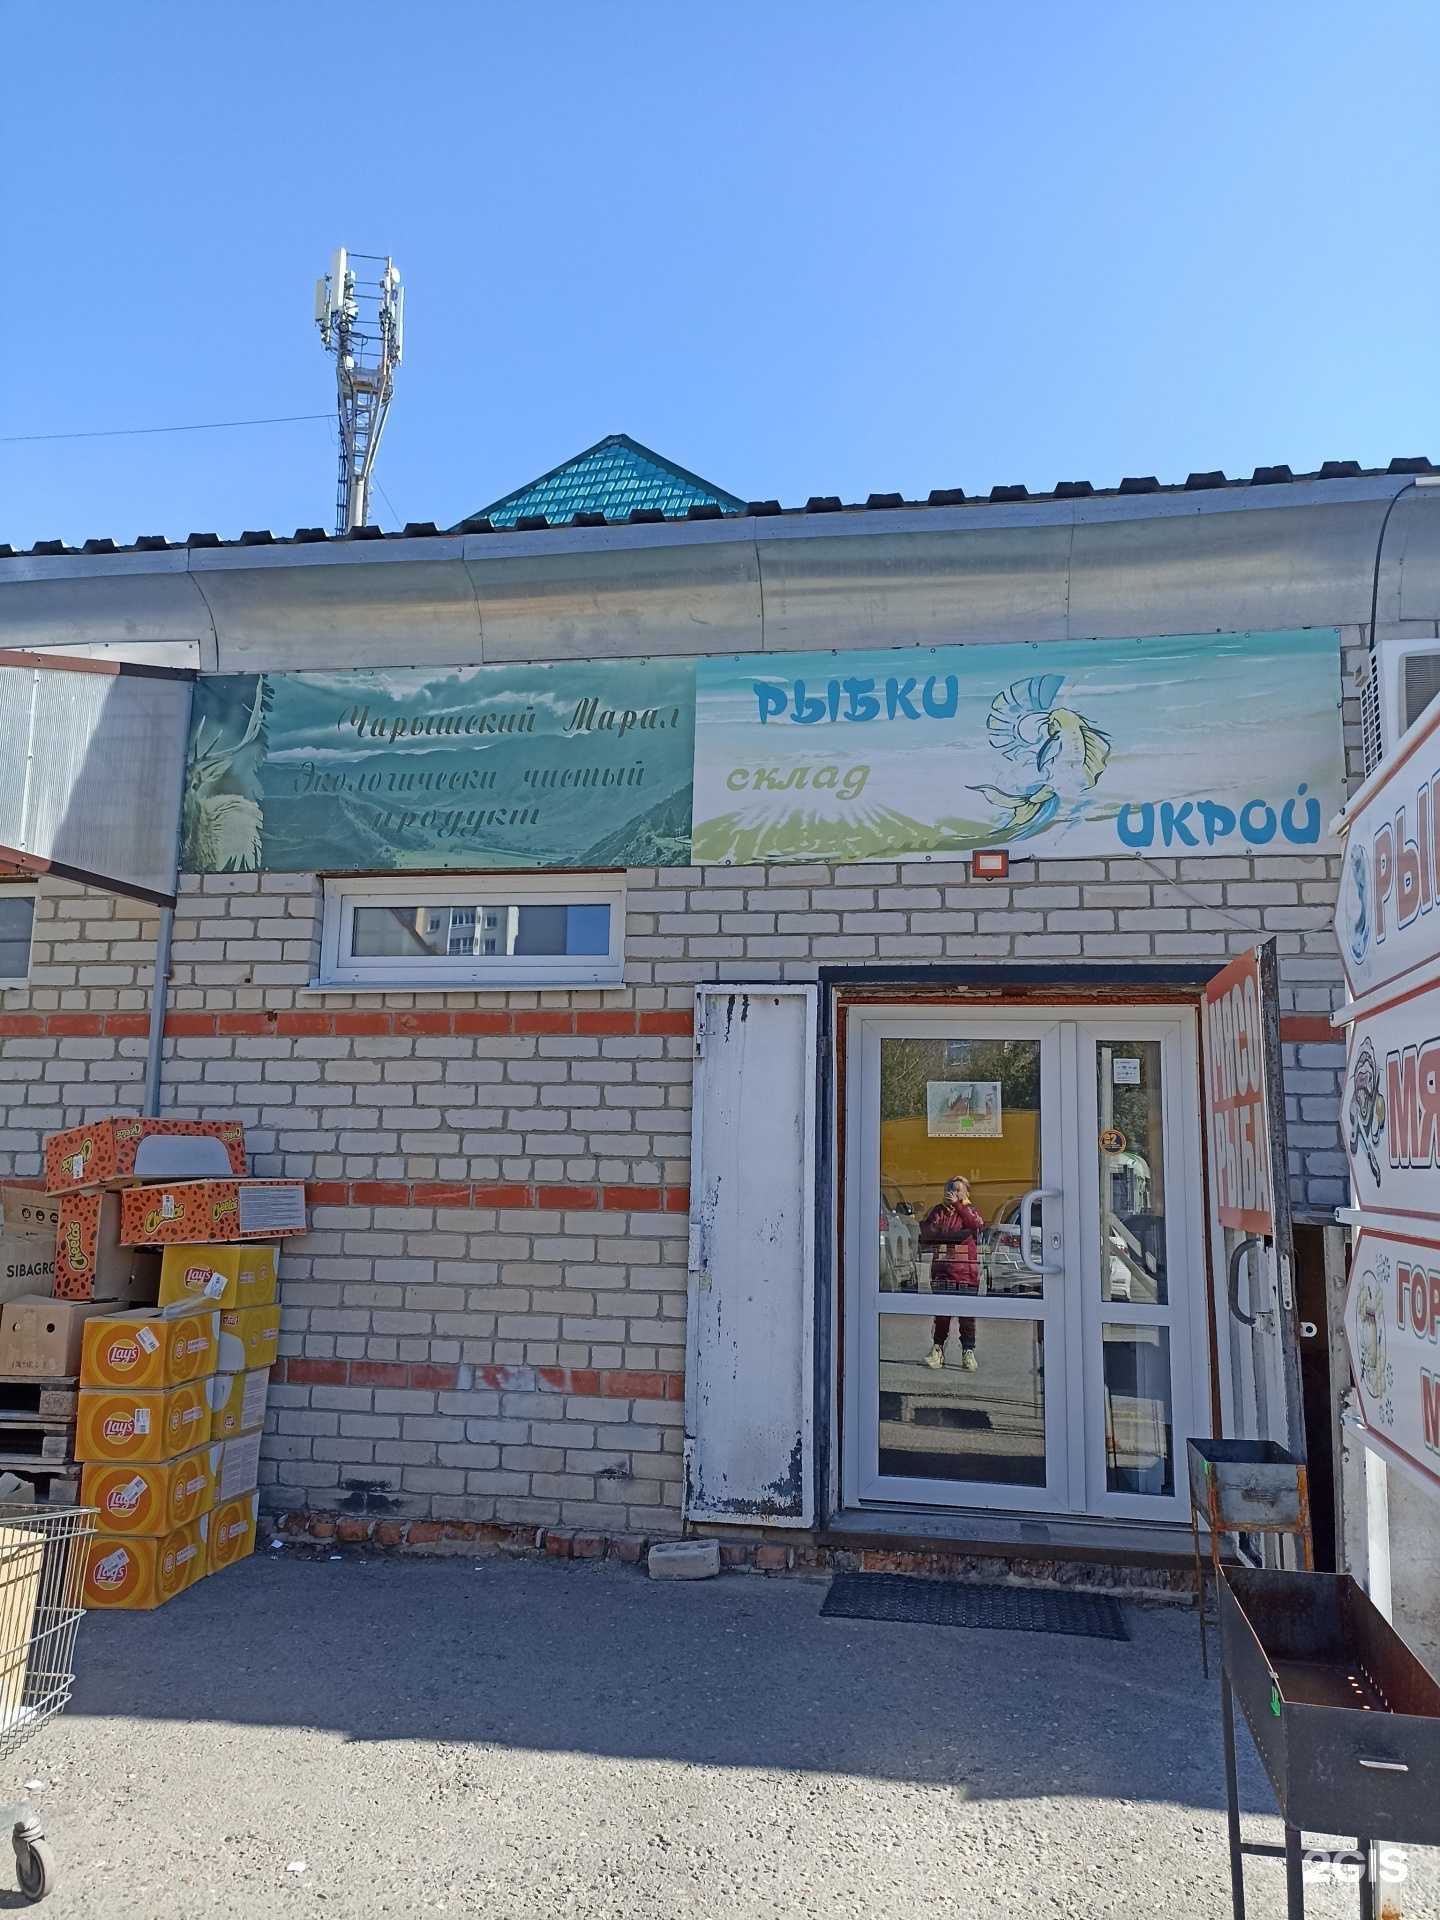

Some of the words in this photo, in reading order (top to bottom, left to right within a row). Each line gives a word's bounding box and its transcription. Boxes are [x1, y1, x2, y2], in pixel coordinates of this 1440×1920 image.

[337, 704, 536, 744] Чарышский
[562, 697, 679, 738] Марал
[753, 674, 958, 725] РЫБКИ
[294, 761, 497, 792] Экологически
[524, 760, 645, 788] чистый
[726, 763, 871, 801] склад
[372, 803, 540, 838] продукт
[1116, 783, 1321, 848] ИКРОЙ
[1210, 976, 1260, 1102] МЯСО
[1215, 1101, 1270, 1212] РЫБА
[67, 1220, 89, 1271] Cheetos
